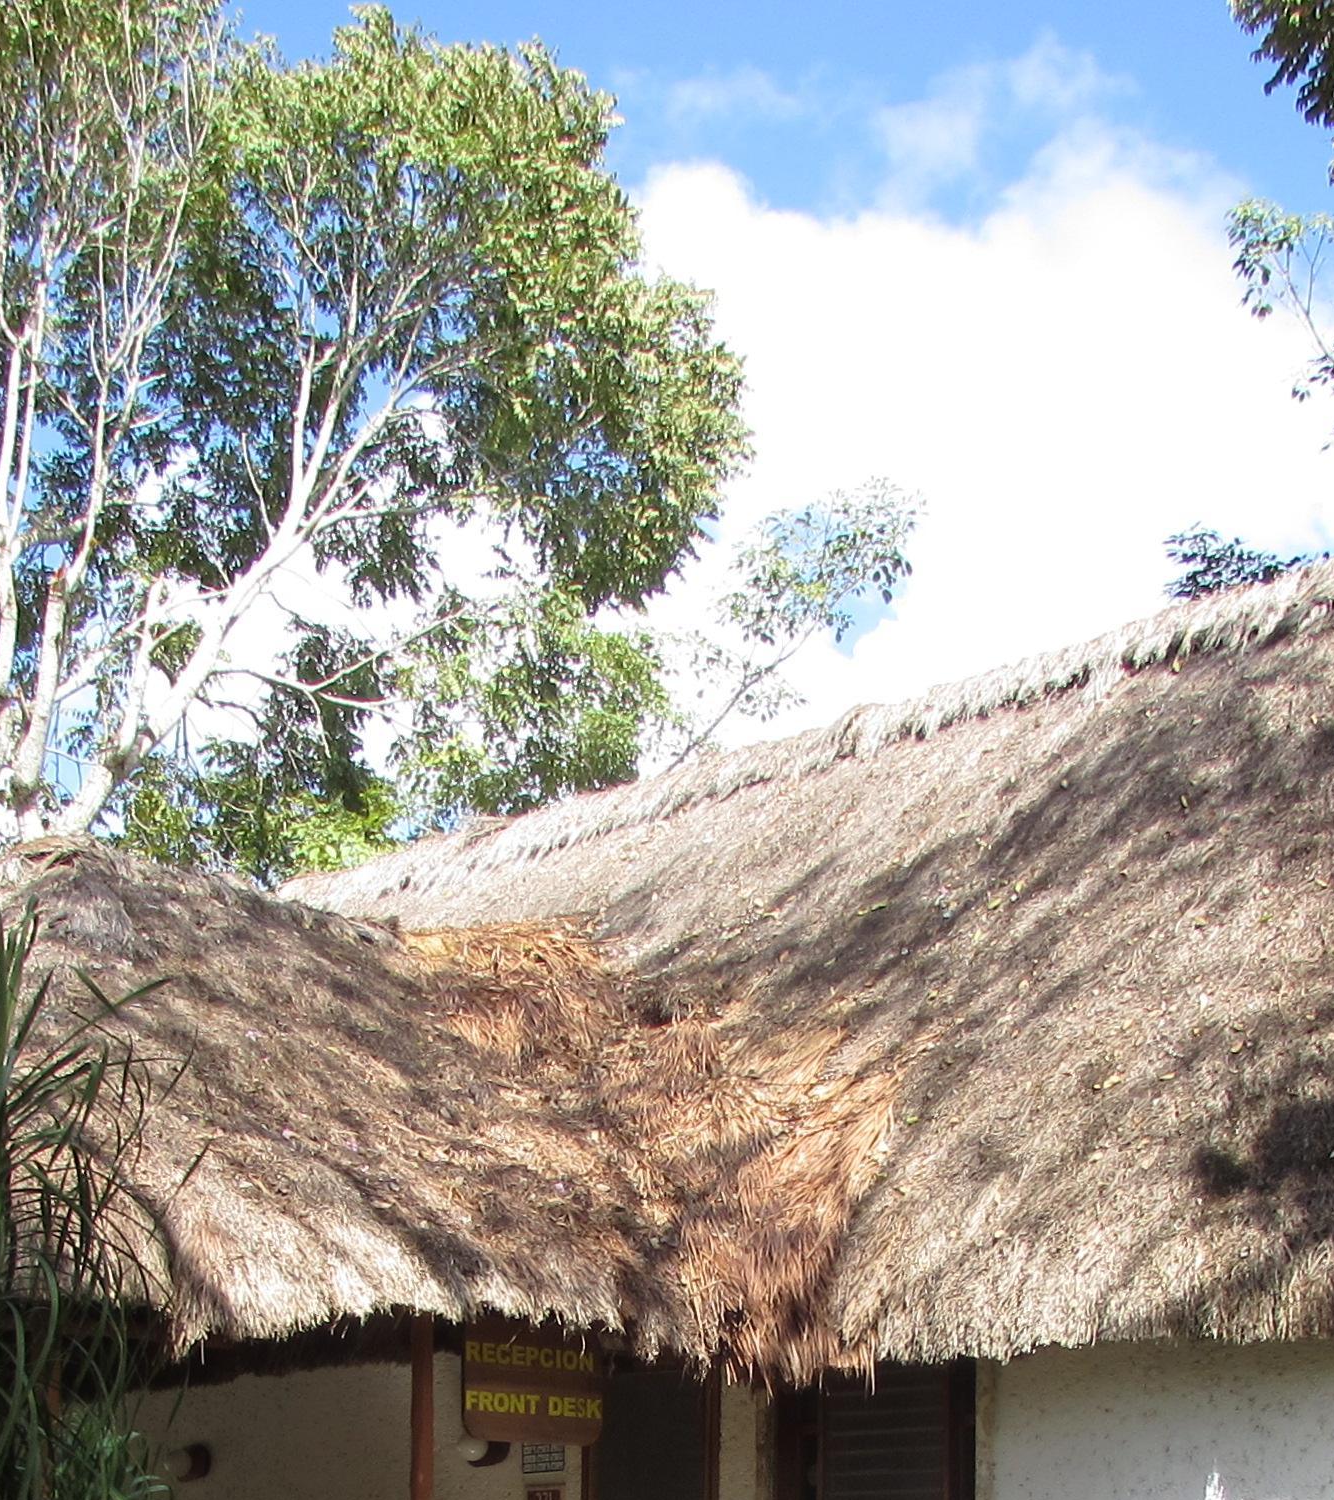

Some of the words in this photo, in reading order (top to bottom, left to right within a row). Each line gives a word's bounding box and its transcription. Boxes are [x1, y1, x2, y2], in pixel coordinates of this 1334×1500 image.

[465, 1341, 595, 1371] RECEPCION
[466, 1390, 540, 1415] FRONT
[548, 1396, 602, 1419] DESK
